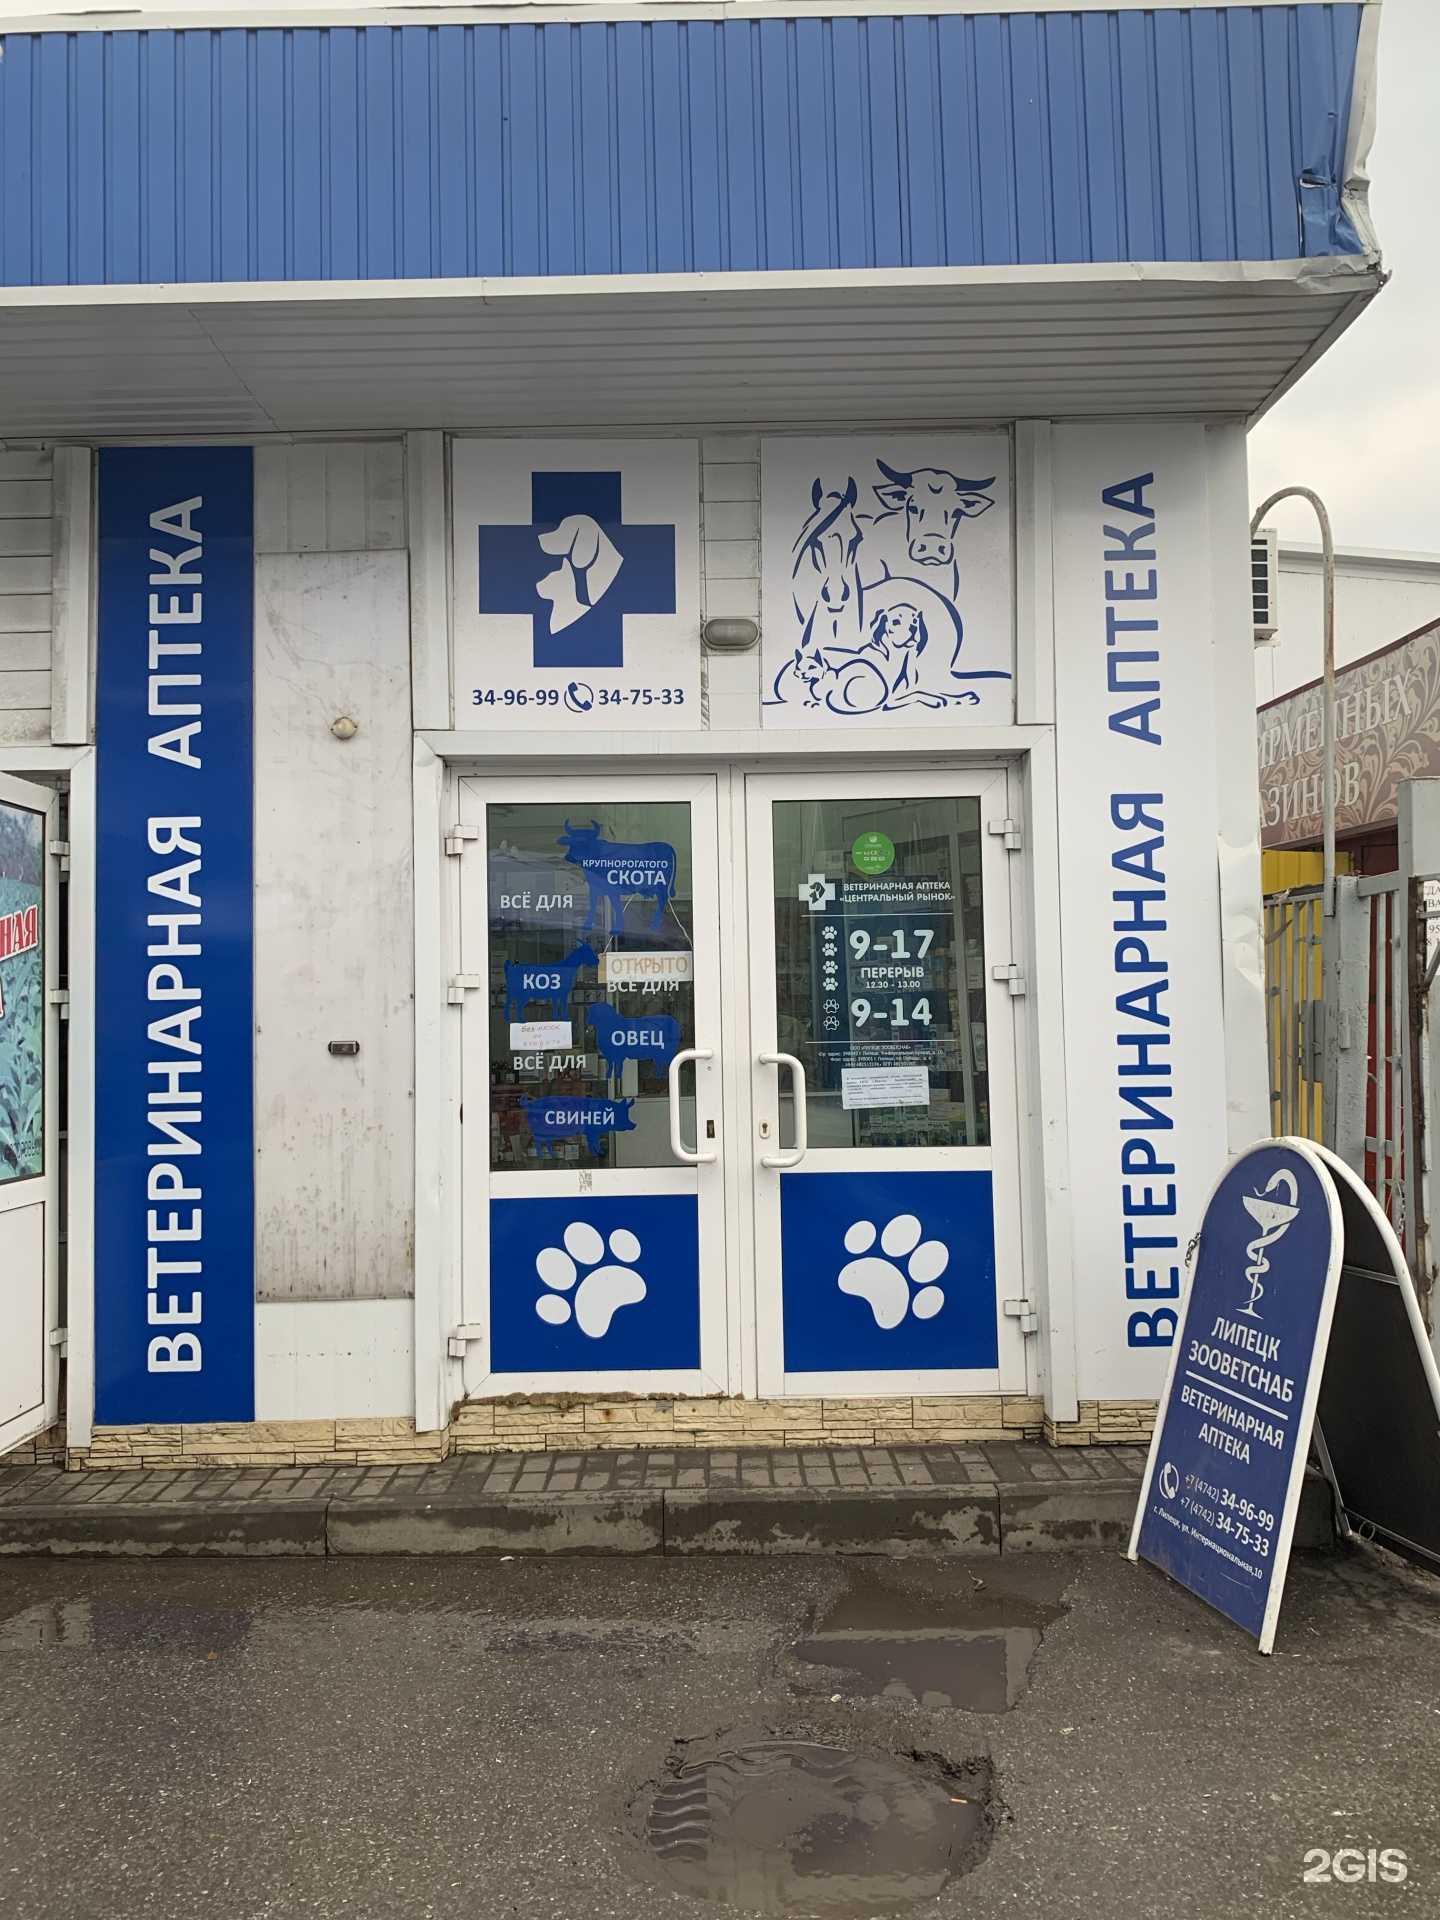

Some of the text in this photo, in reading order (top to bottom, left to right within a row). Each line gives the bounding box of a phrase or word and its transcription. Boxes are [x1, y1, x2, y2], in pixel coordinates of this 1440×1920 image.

[471, 688, 560, 706] 34-96-99
[598, 688, 685, 705] 34-75-33
[582, 858, 669, 869] КРУПНОРОГАТОГО
[606, 869, 667, 886] СКОТА
[843, 881, 951, 892] ВЕТЕРИНАРНАЯ АПТЕКА
[500, 890, 574, 912] ВСЁ ДЛЯ
[1101, 471, 1179, 1348] ВЕТЕРИНАРНАЯ АПТЕКА
[147, 495, 203, 1374] ВЕТЕРИНАРНАЯ АПТЕКА
[849, 929, 935, 961] 9-17
[611, 957, 688, 975] ОТКРЫТО
[860, 966, 925, 979] ПЕРЕРЫВ
[523, 973, 561, 990] КОЗ
[850, 997, 933, 1028] 9-14
[611, 1029, 665, 1050] ОВЕЦ
[513, 1051, 587, 1073] ВСЁ ДЛЯ
[544, 1106, 615, 1126] СВИНЕЙ
[1210, 1316, 1281, 1363] ЛИПЕЦК
[1188, 1339, 1295, 1404] ЗООВЕТСНАБ
[1180, 1385, 1286, 1451] ВЕТЕРИНАРНАЯ
[1197, 1422, 1251, 1465] АПТЕКА
[1184, 1473, 1275, 1532] +7 (4742) 34-96-99
[1180, 1496, 1270, 1558] +7 (4742) 34-75-33
